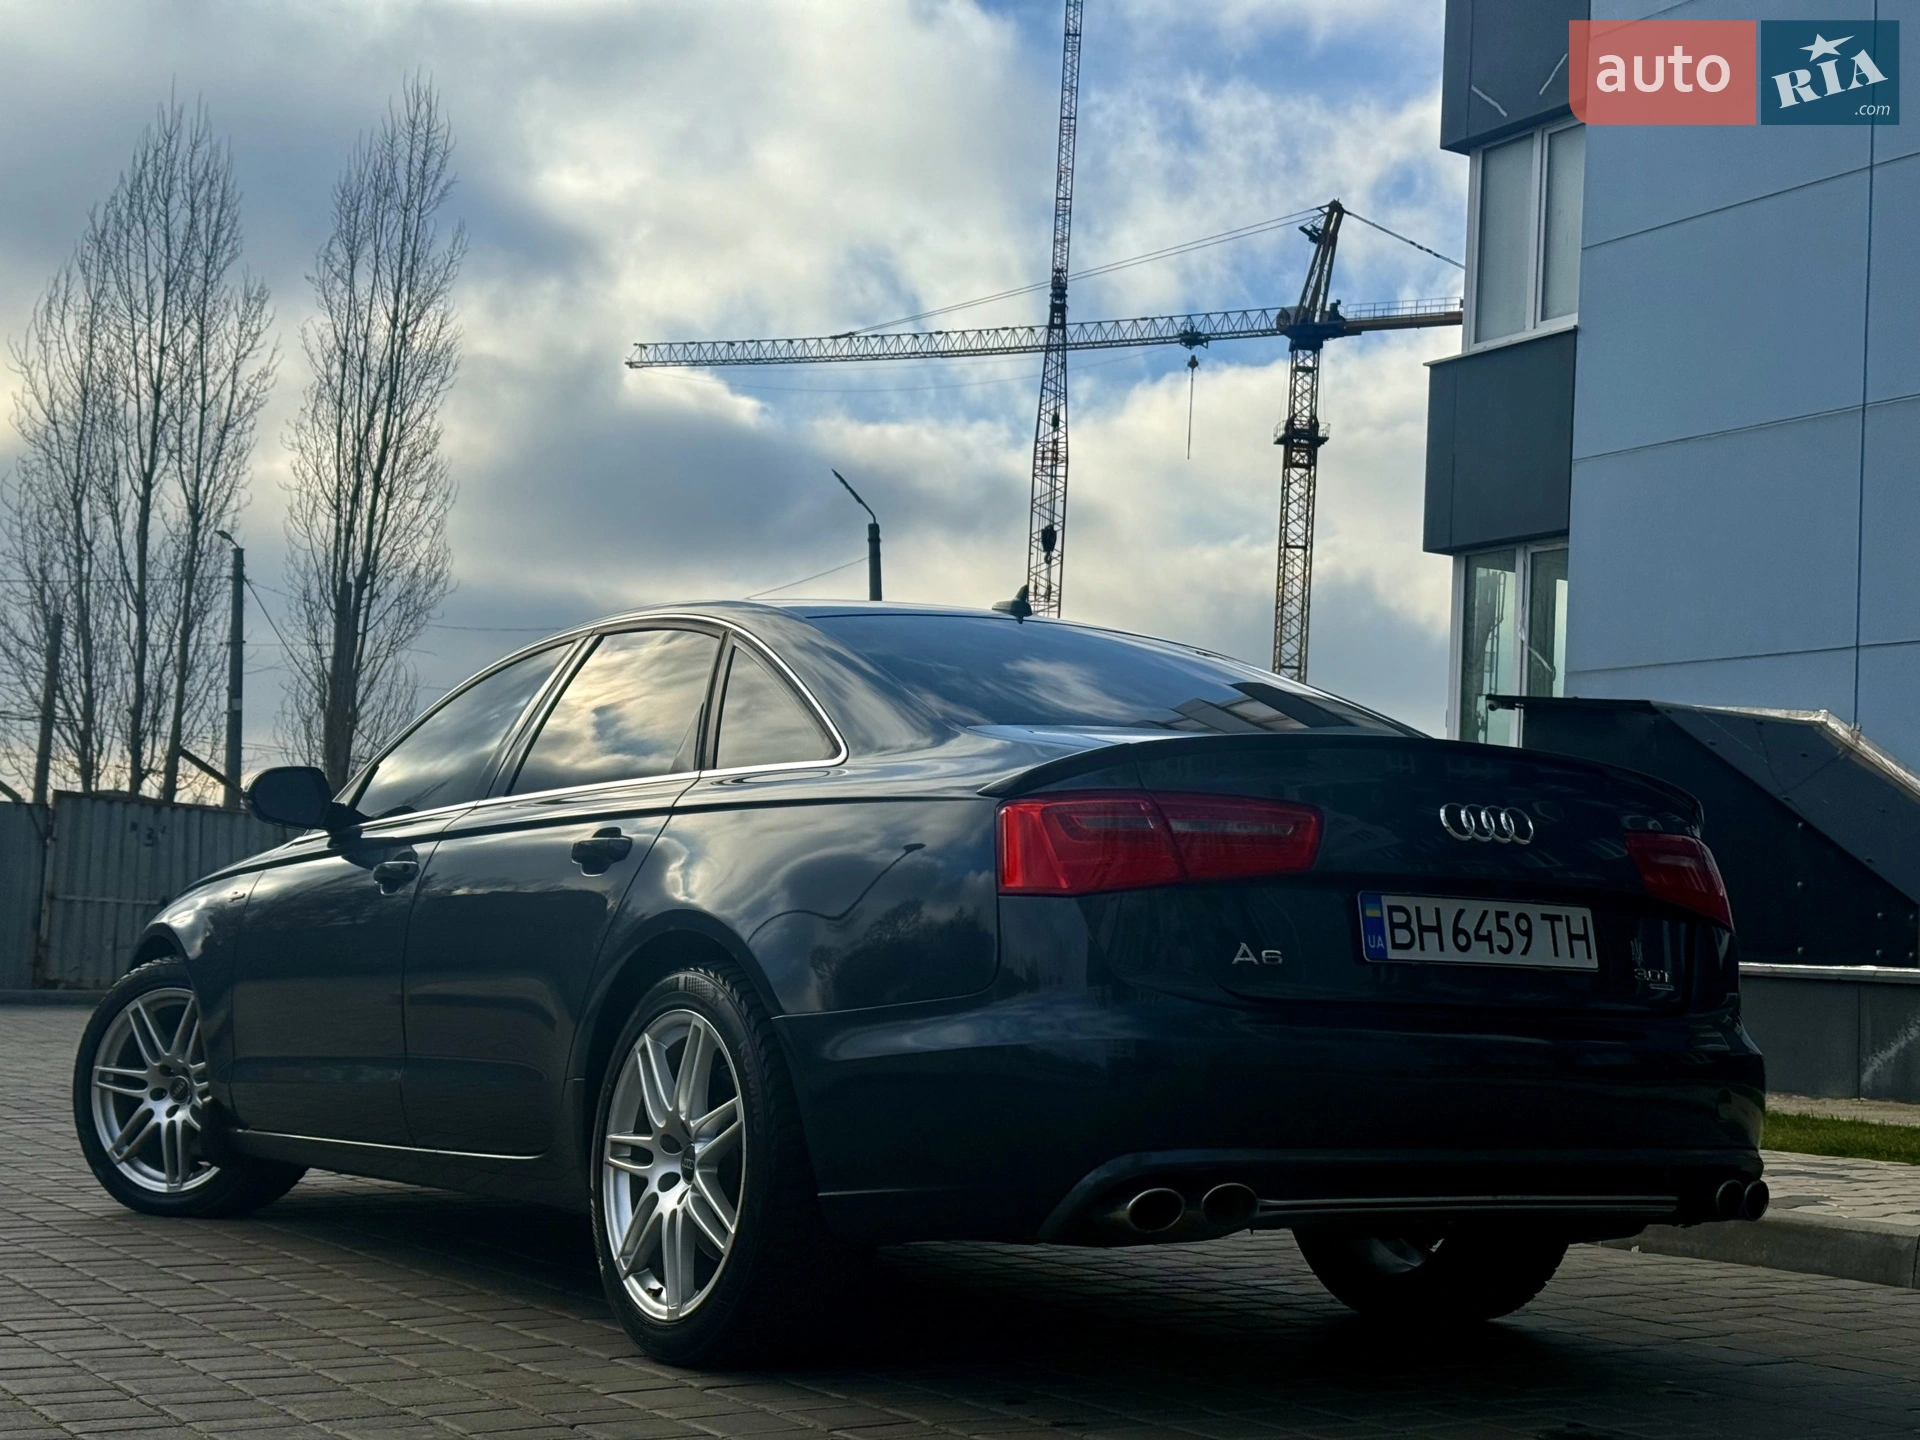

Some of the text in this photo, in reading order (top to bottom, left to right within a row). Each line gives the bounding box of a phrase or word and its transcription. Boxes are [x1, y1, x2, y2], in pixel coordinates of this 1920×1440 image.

[1367, 933, 1385, 950] UA
[1387, 904, 1592, 960] BH 6459 TH
[1231, 941, 1283, 965] A6
